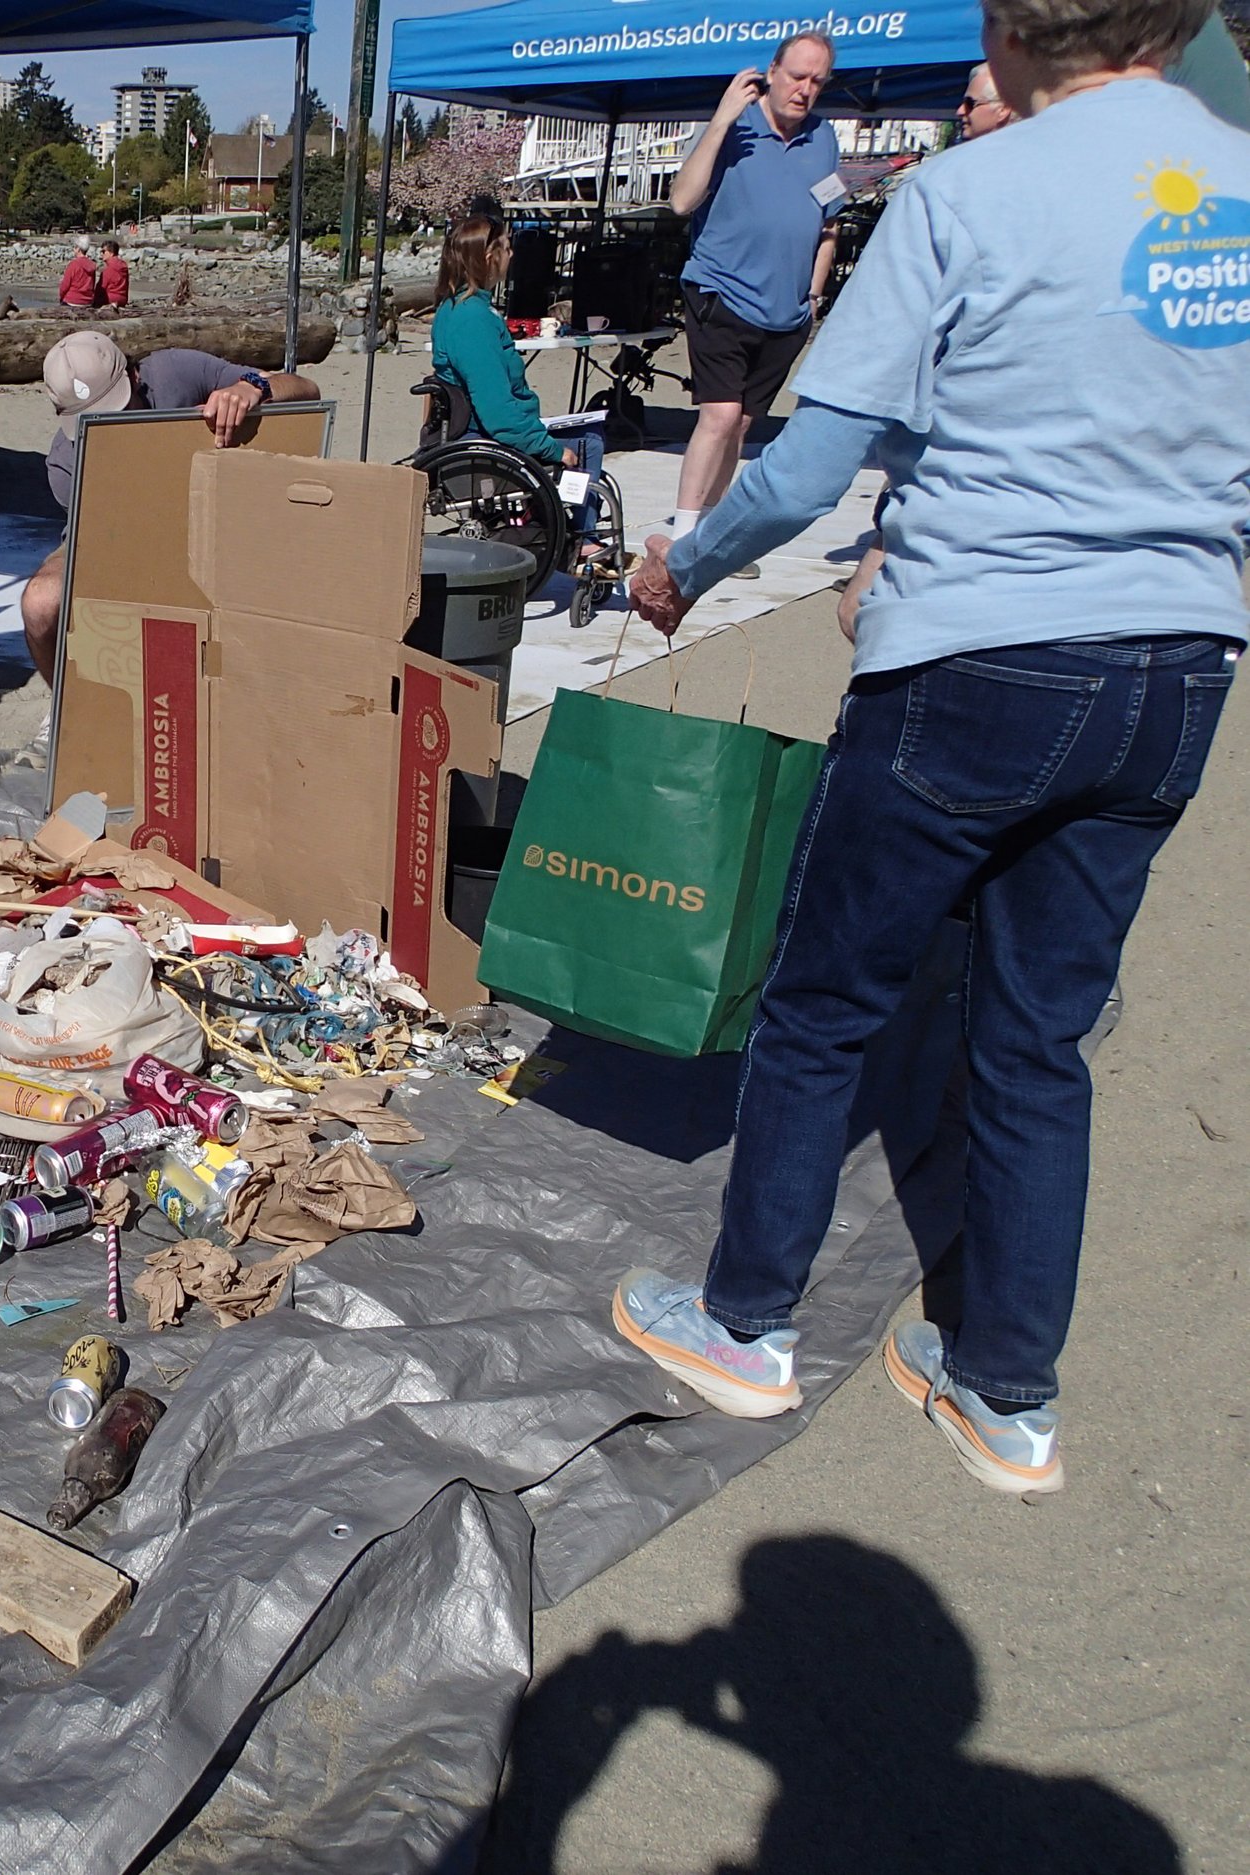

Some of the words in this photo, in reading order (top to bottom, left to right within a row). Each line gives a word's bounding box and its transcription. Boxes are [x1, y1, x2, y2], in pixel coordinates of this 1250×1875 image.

[512, 10, 907, 58] oceanambassadorscanada.org
[1148, 239, 1190, 254] WEST
[1192, 235, 1250, 251] VANCOU
[1147, 252, 1250, 293] Positi
[153, 692, 170, 818] AMBROSIA
[412, 770, 431, 907] AMBROSIA
[545, 850, 706, 912] simons
[75, 1043, 114, 1065] PRICE
[705, 1340, 767, 1374] HOKA
